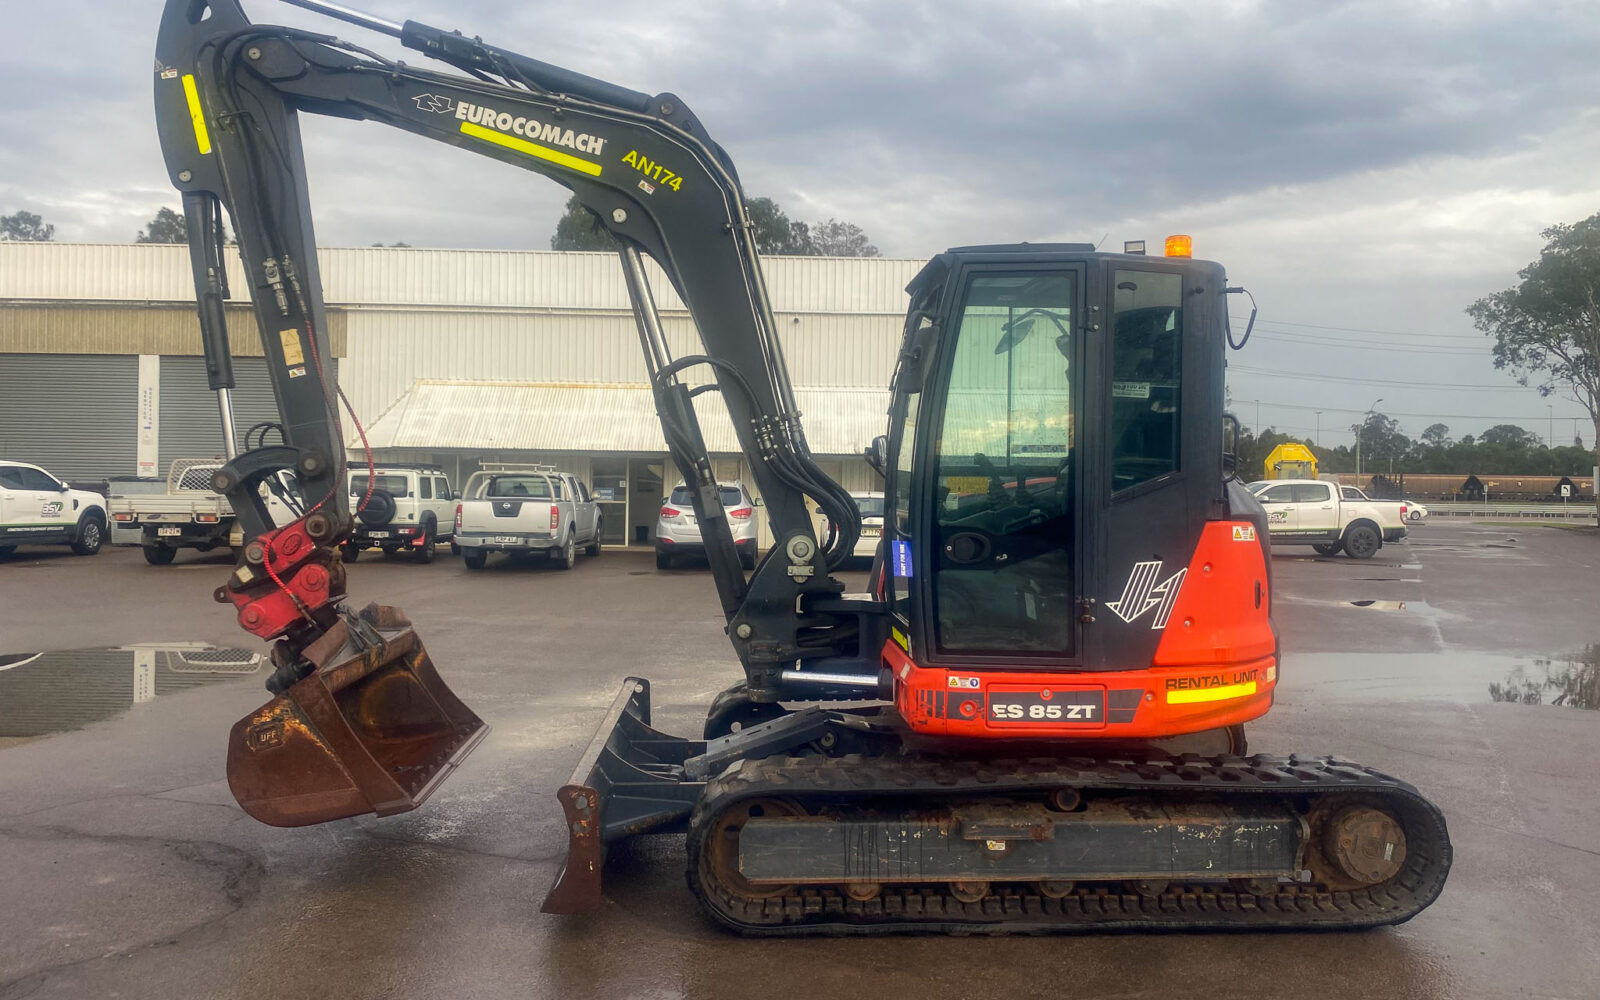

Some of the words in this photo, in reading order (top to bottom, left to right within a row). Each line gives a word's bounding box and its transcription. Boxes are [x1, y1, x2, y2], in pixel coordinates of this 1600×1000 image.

[455, 101, 604, 156] EUROCOMACH
[621, 150, 683, 192] AN174
[1165, 675, 1229, 690] RENTAL
[1233, 669, 1258, 684] UNIT
[992, 704, 1024, 719] ES
[1029, 704, 1062, 719] 85
[1066, 704, 1096, 719] ZT
